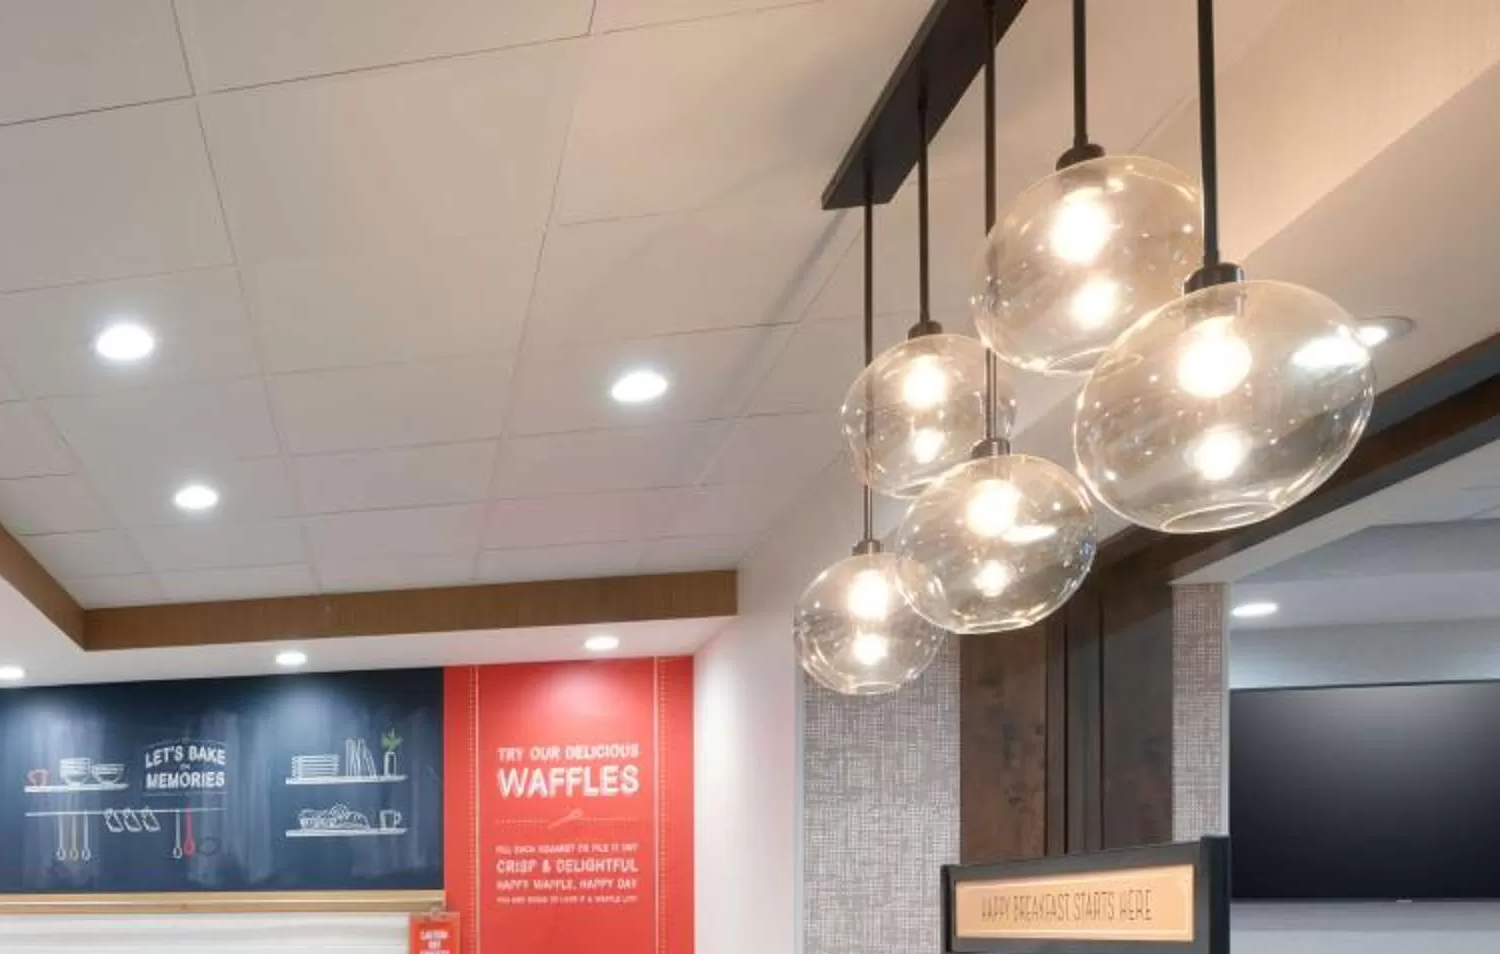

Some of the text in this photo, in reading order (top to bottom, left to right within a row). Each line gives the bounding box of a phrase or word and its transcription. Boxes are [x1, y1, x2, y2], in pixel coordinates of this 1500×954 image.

[145, 745, 226, 769] LET'S BAKE
[497, 743, 640, 762] TRY OUR DELICIOUS
[146, 771, 226, 789] MEMORIES
[497, 764, 640, 798] WAFFLES
[496, 858, 640, 874] CRISP & DELIGHTFUL
[579, 879, 615, 890] HAPPY
[981, 889, 1153, 922] HAPPY BREAKFAST STARTS HERE
